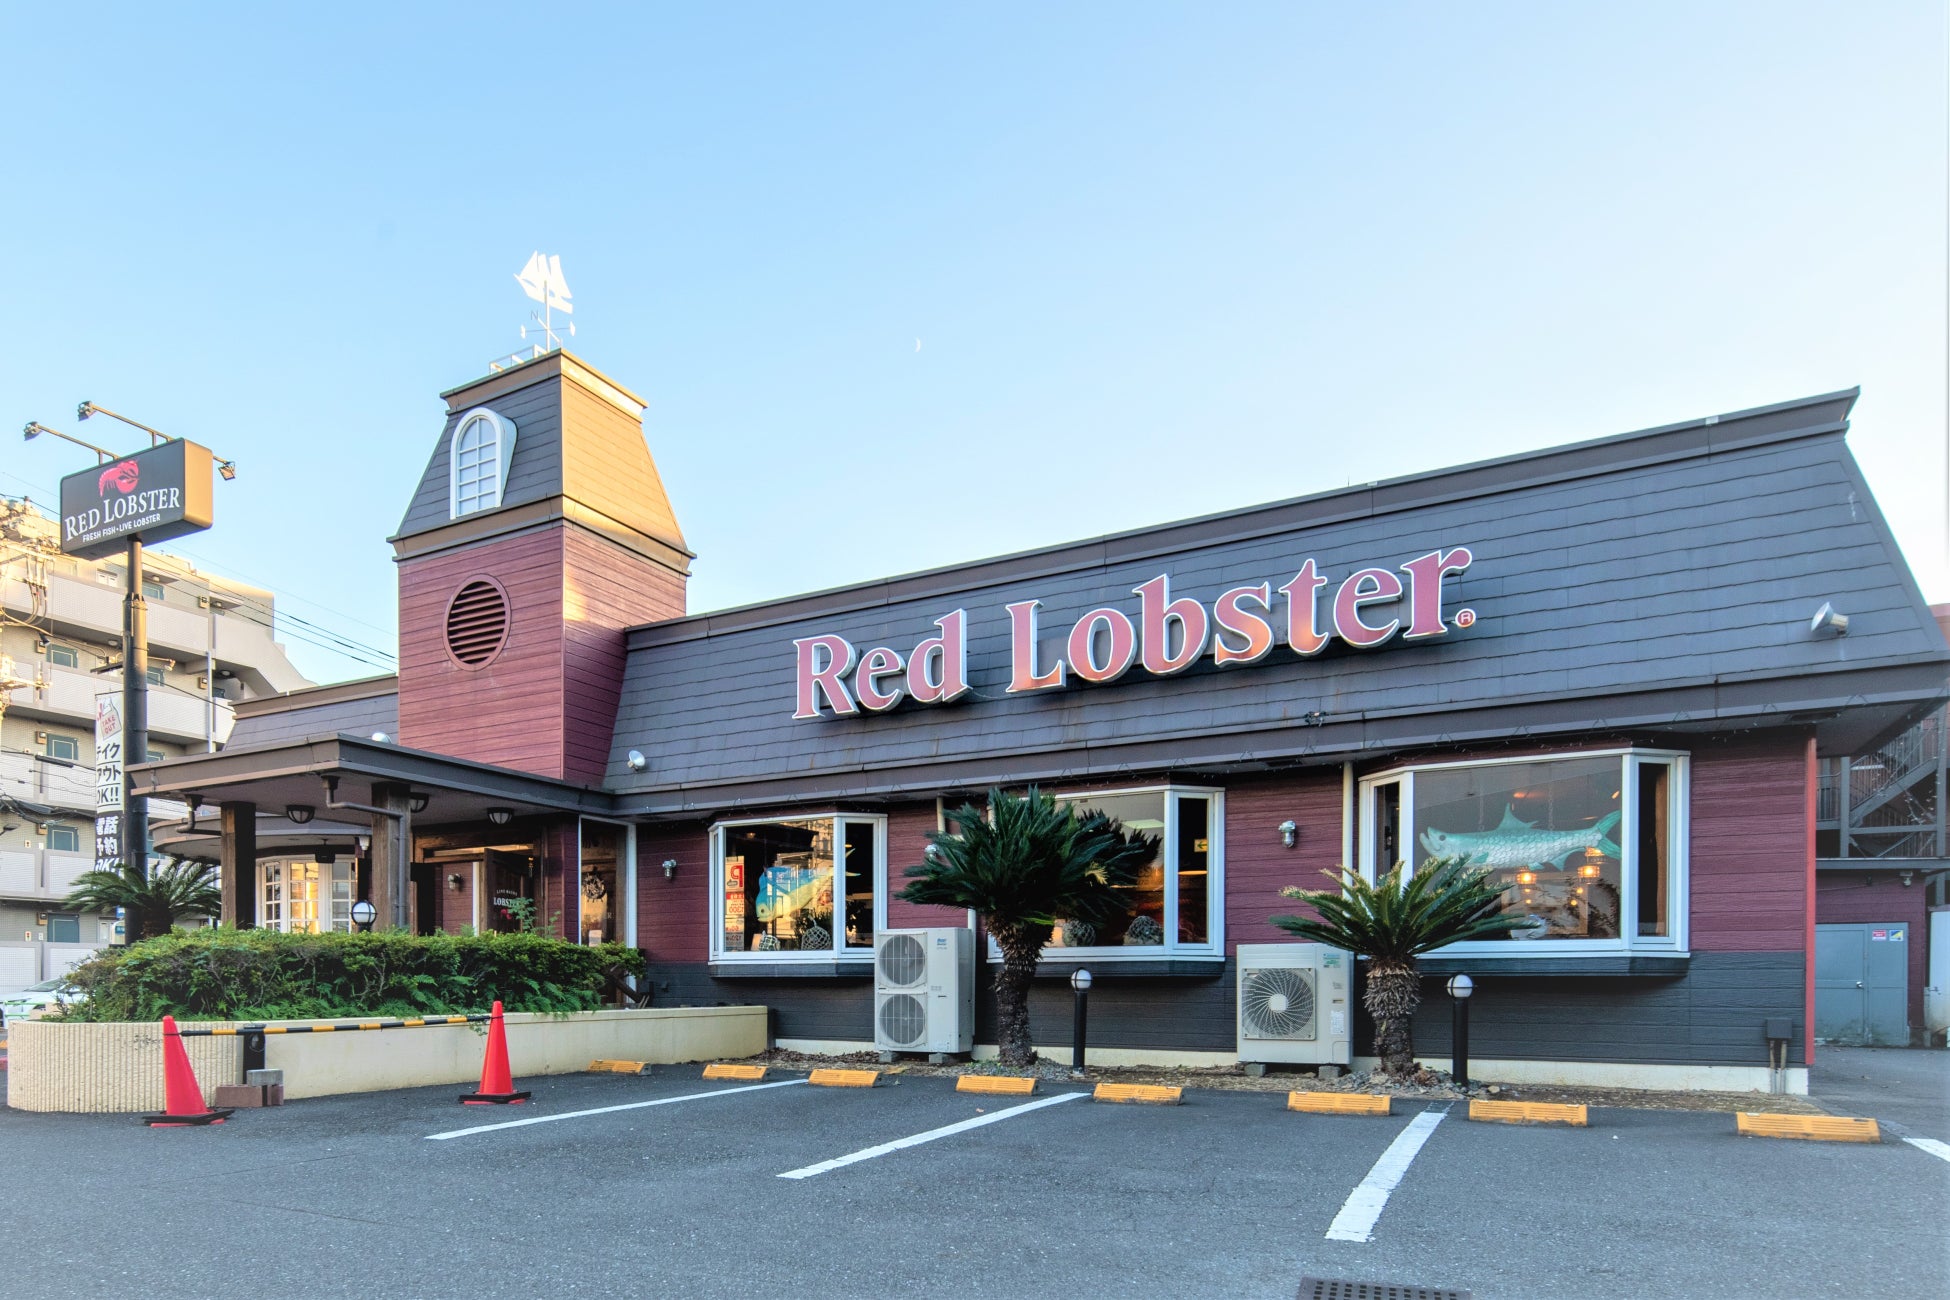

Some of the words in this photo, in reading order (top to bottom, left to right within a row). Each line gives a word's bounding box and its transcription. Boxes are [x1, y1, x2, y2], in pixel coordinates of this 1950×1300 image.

[65, 508, 100, 542] RED
[103, 487, 180, 524] LOBSTER
[82, 530, 102, 543] FRESH
[133, 513, 161, 528] LOBSTER
[792, 607, 973, 720] Red
[1004, 547, 1474, 694] Lobster
[102, 714, 116, 728] TAKE
[104, 722, 116, 734] OUT
